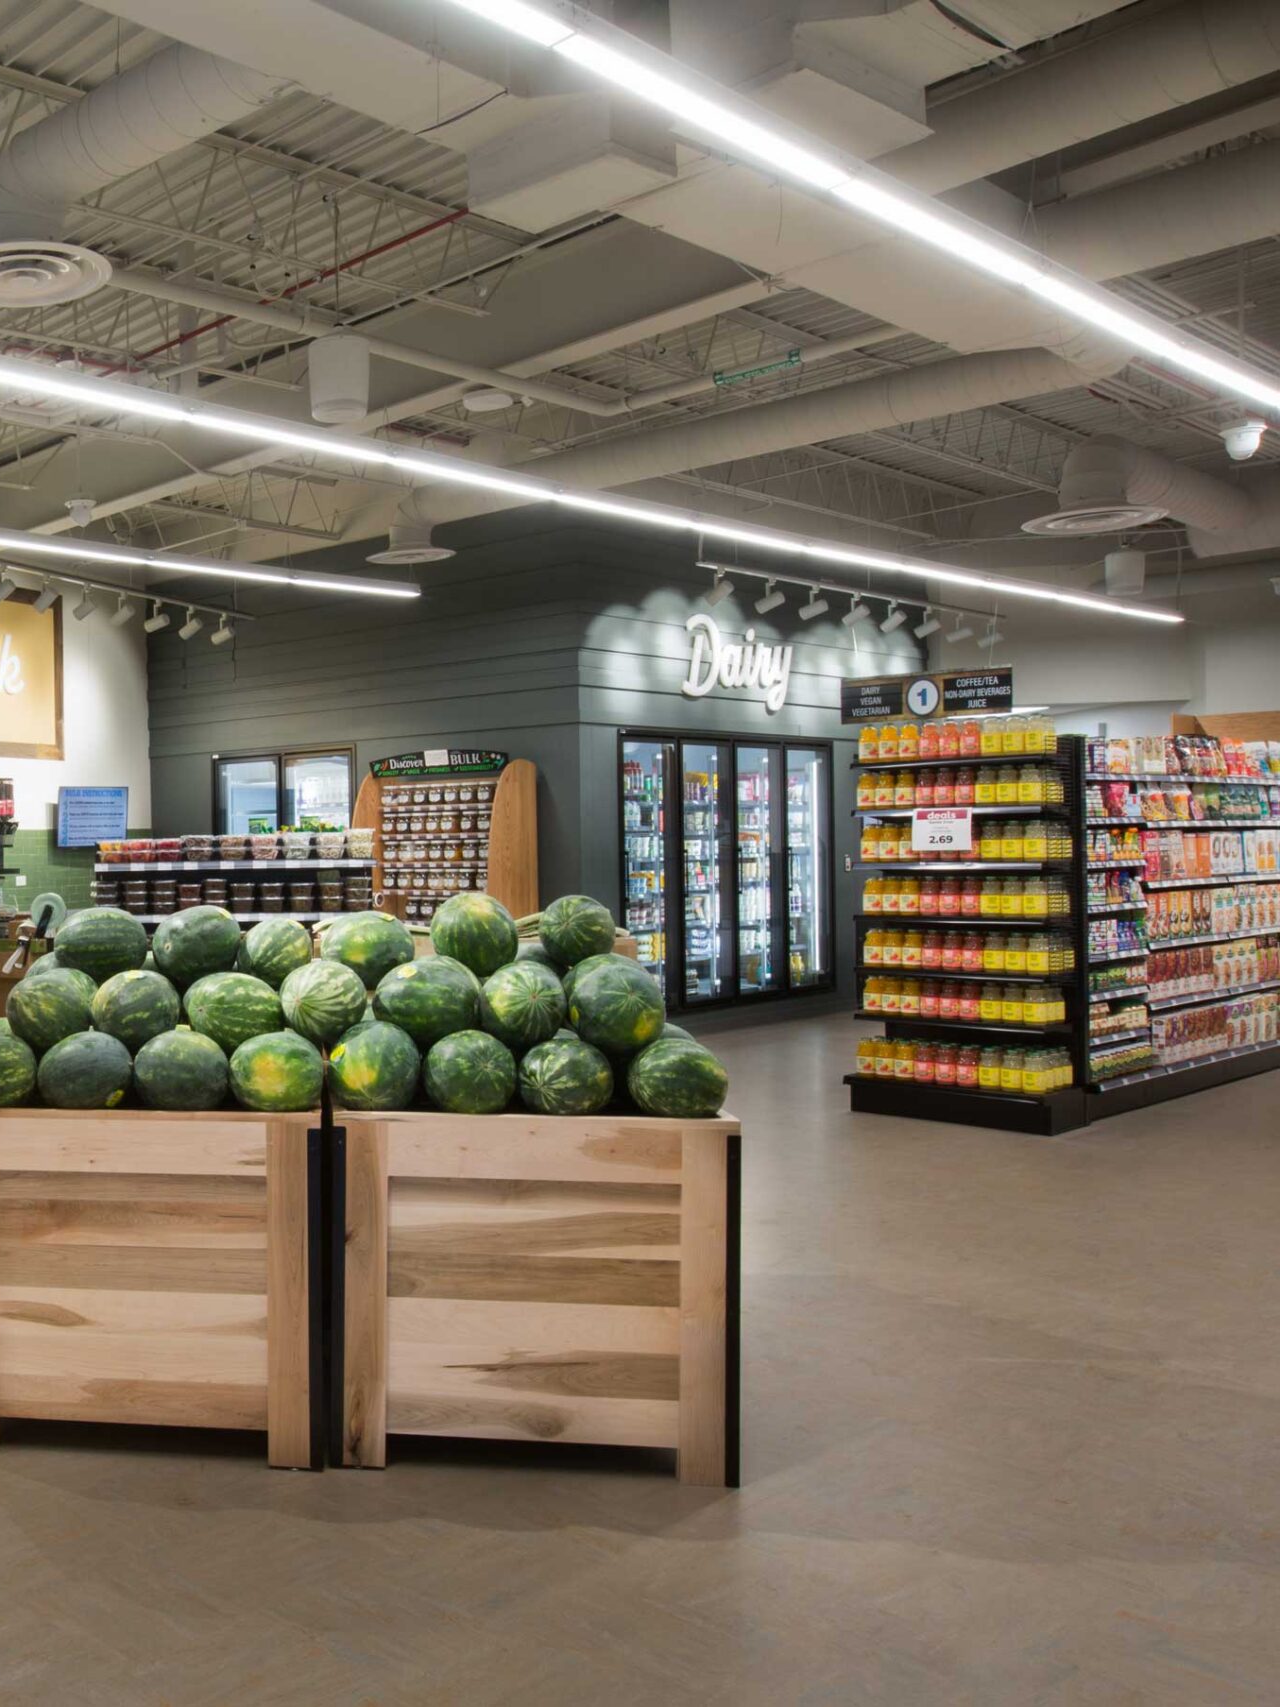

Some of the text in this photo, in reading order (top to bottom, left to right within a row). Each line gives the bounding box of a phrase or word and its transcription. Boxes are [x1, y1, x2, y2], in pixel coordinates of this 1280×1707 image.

[682, 613, 793, 714] Dairy
[956, 676, 999, 687] COFFEE/TEA
[861, 687, 880, 696] DAIRY
[917, 688, 927, 706] 1
[945, 686, 1011, 699] NON-DAIRY BEVERAGES
[860, 697, 882, 706] VEGAN
[968, 699, 987, 708] JUICE
[852, 706, 891, 717] VEGETARIAN
[450, 753, 481, 765] BULK
[927, 811, 957, 820] deals
[928, 835, 953, 844] 2.69
